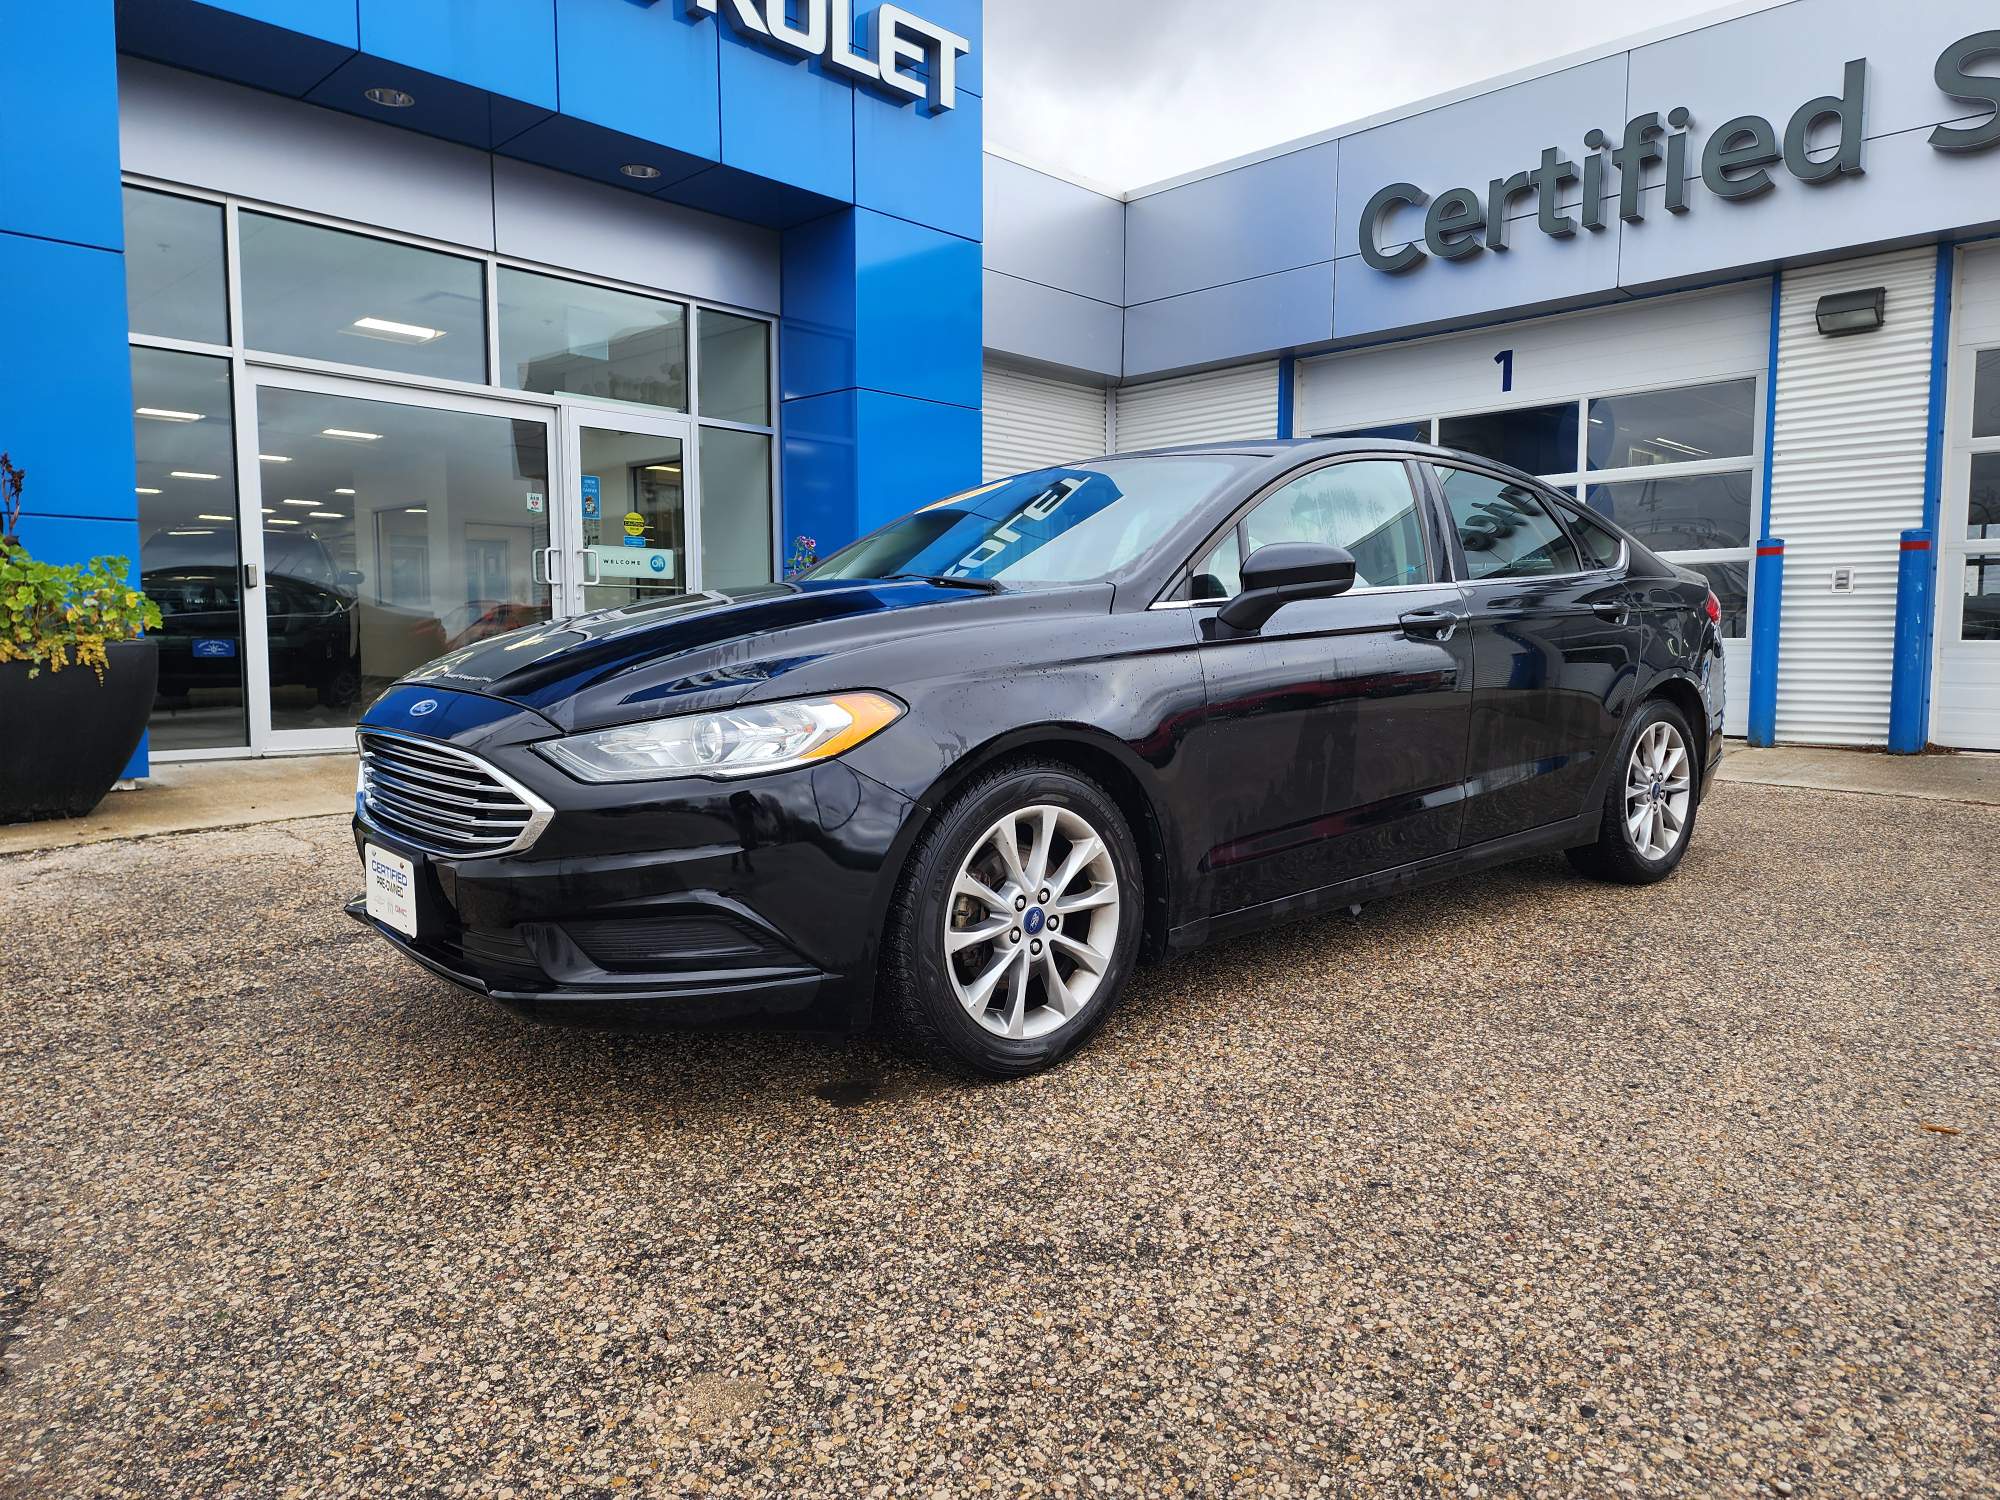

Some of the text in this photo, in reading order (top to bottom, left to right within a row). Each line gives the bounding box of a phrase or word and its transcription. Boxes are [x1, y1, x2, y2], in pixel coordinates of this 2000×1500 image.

[1358, 57, 1868, 272] Certified
[1494, 350, 1513, 392] 1
[371, 859, 408, 887] CERTIFIED
[376, 875, 404, 898] PRE-OWNED
